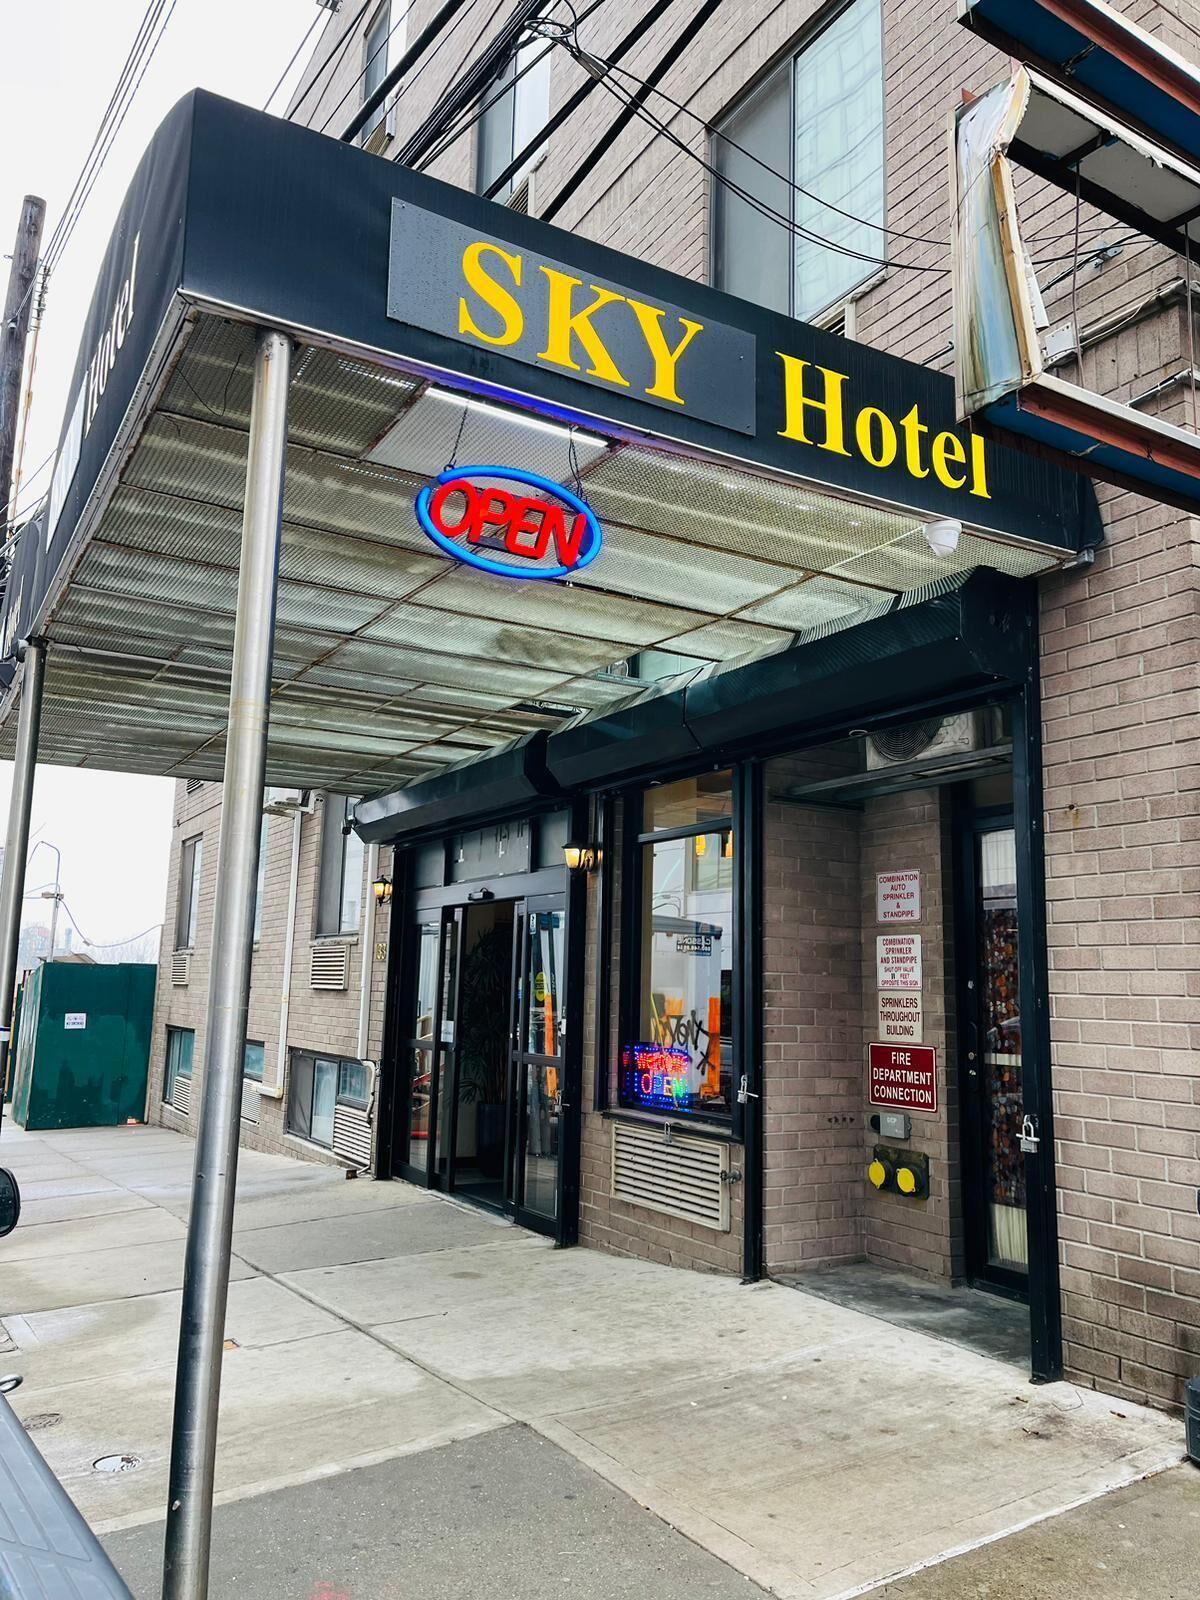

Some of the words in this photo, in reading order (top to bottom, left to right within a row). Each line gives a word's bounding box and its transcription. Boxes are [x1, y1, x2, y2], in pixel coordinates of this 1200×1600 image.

[458, 241, 704, 405] SKY
[775, 351, 992, 499] Hotel
[430, 478, 587, 569] OPEN
[879, 874, 918, 883] COMBINATION
[890, 883, 906, 891] AUTO
[883, 892, 914, 901] SPRINKLER
[883, 910, 914, 918] STANDPIPE
[882, 937, 915, 946] COMBINATION
[885, 947, 912, 955] SPRINKLER
[880, 956, 890, 964] AND
[891, 956, 917, 964] STANDPIPE
[881, 997, 918, 1008] SPRINKLERS
[880, 1011, 920, 1022] THROUGHOUT
[886, 1025, 914, 1036] BUILDING
[891, 1052, 912, 1066] FIRE
[873, 1067, 932, 1086] DEPARTMENT
[641, 1073, 686, 1098] OPEN
[874, 1085, 932, 1104] CONNECTION
